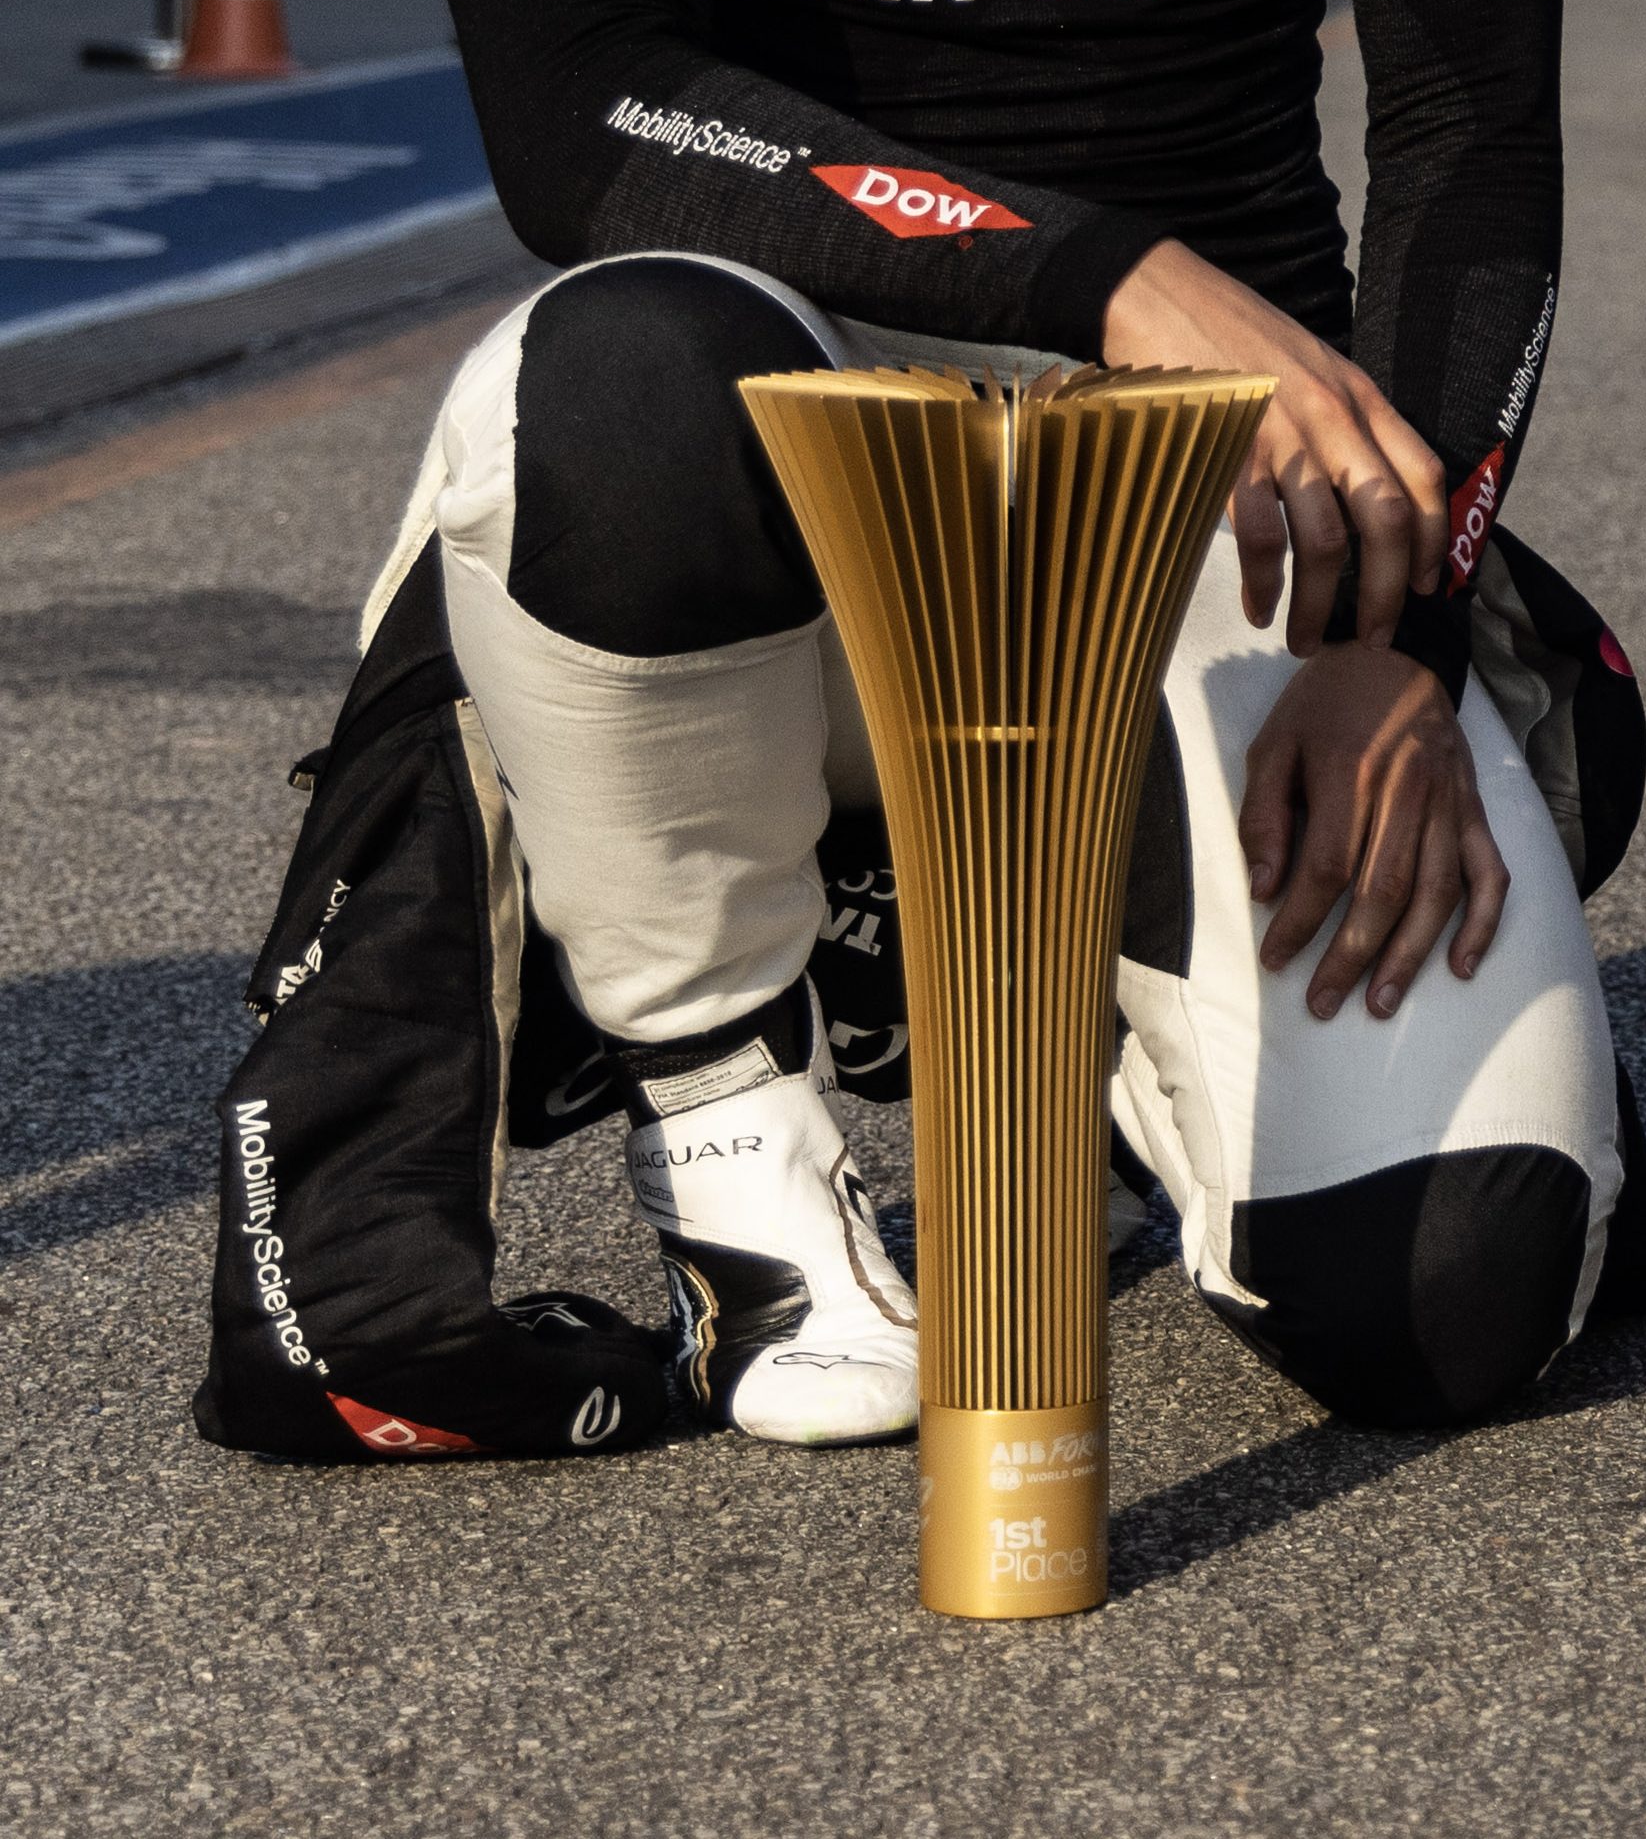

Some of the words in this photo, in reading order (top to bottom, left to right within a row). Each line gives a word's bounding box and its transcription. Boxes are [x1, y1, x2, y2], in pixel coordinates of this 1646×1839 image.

[990, 1441, 1046, 1465] ABB
[989, 1516, 1047, 1550] 1st
[989, 1547, 1087, 1583] Place
